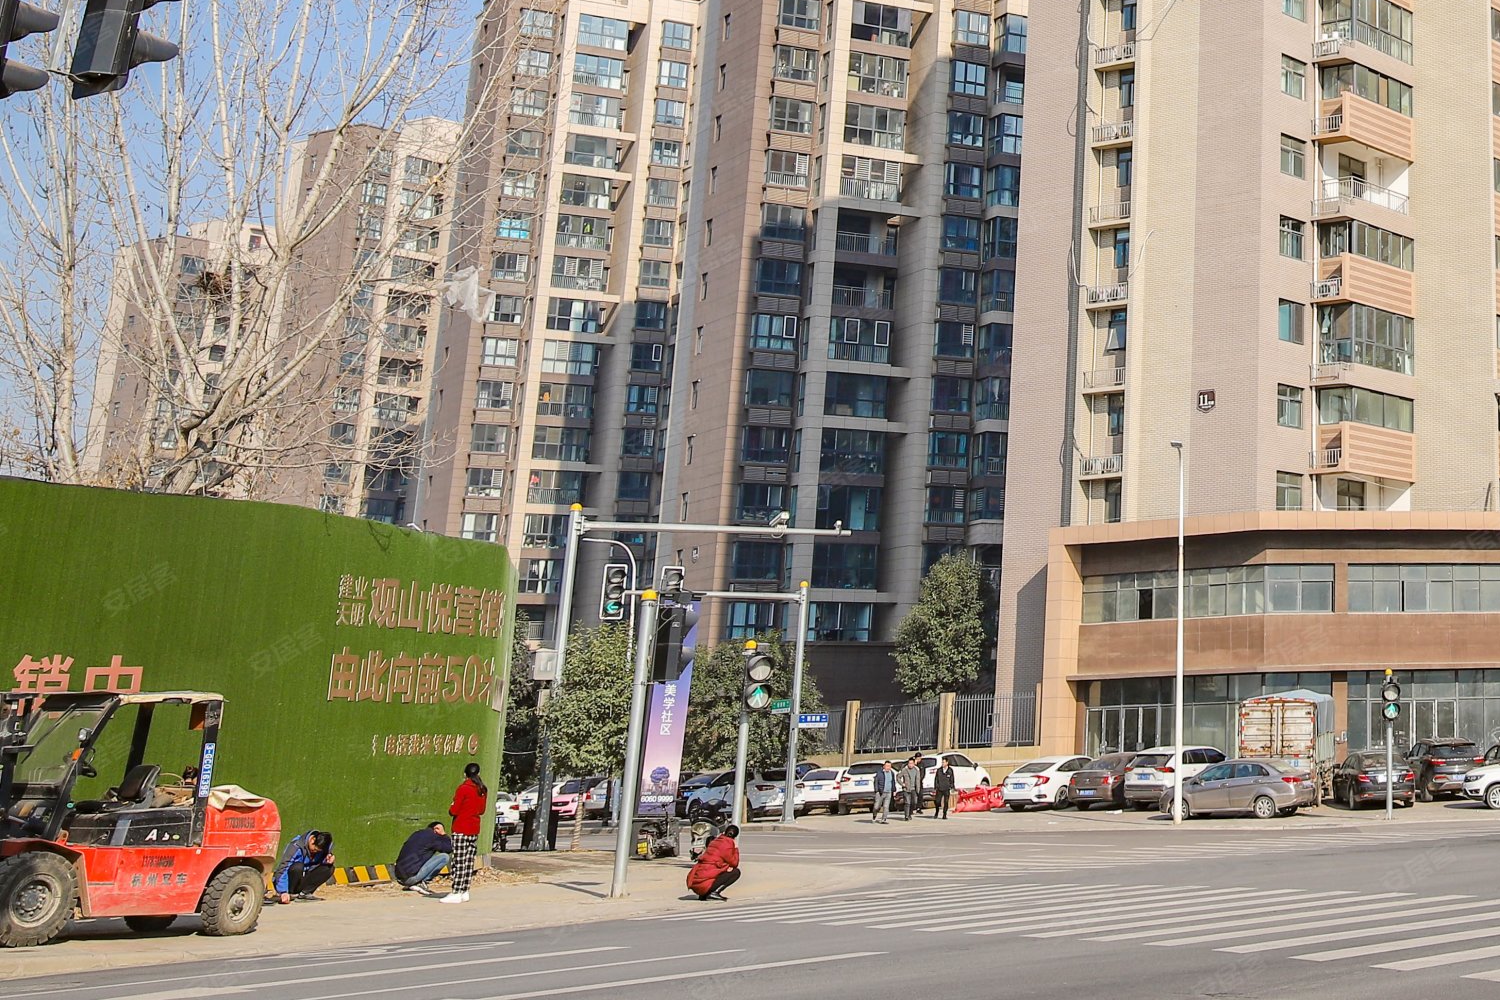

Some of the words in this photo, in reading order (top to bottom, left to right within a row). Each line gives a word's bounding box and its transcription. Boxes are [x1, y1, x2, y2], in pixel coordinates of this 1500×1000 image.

[339, 574, 368, 600] 建业
[336, 601, 367, 627] 天明
[659, 684, 677, 736] 美学社区
